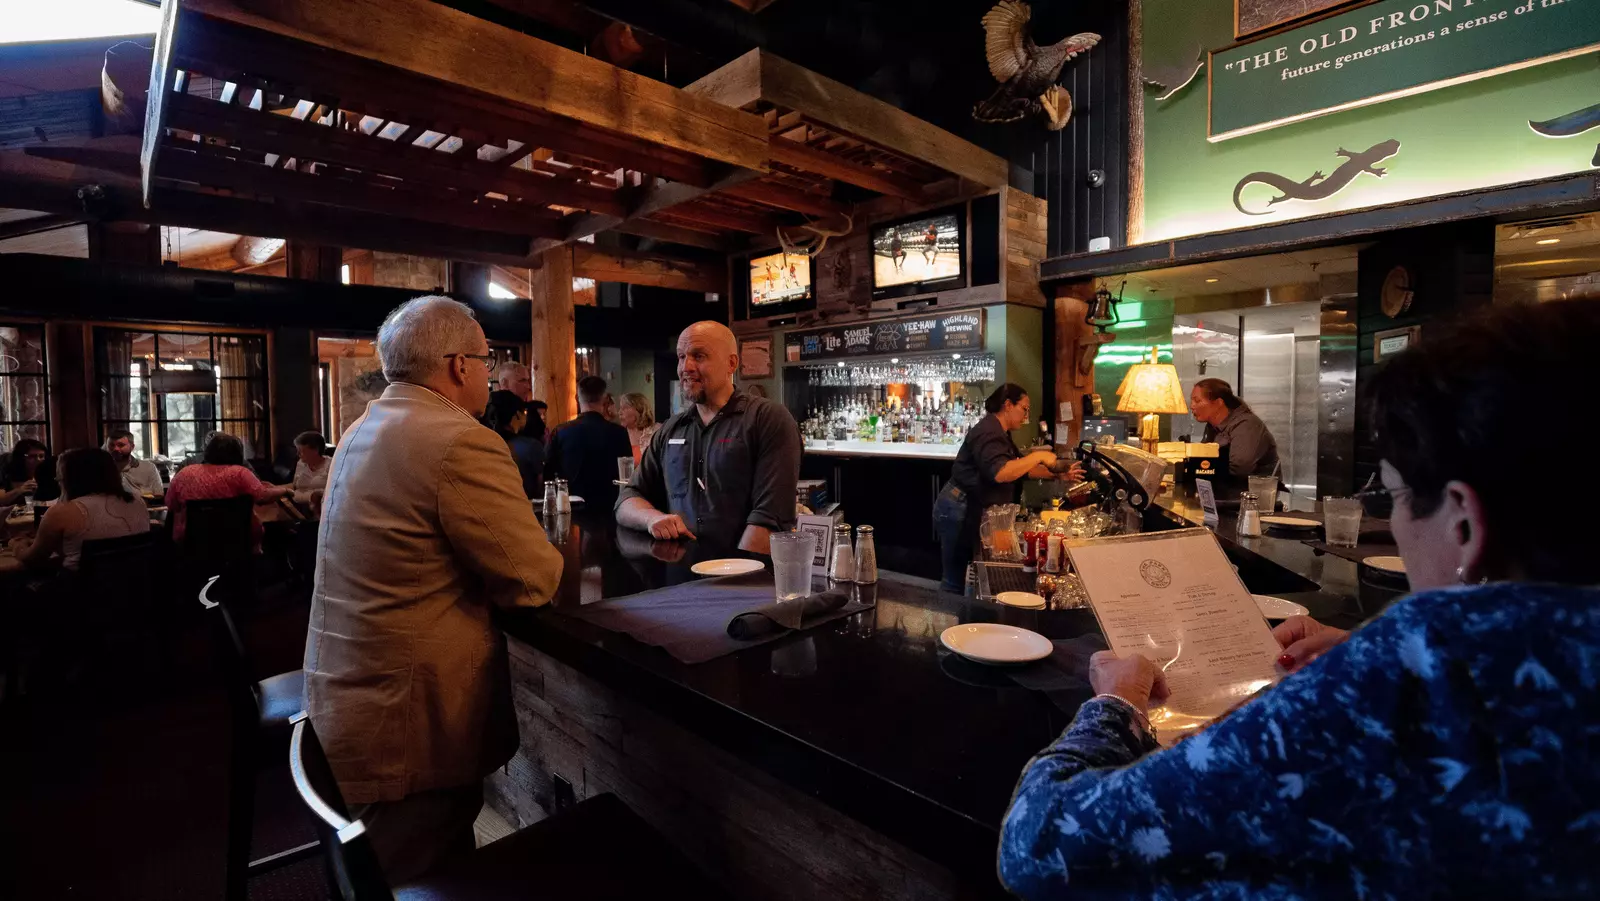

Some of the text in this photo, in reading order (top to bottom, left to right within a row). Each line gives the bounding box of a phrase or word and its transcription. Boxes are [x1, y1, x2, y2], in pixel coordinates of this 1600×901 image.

[1281, 60, 1331, 81] future
[1335, 30, 1435, 69] generations
[1440, 26, 1451, 36] a
[1455, 10, 1508, 32] sense
[1514, 0, 1537, 15] of
[1300, 26, 1358, 54] OLD
[942, 315, 979, 327] HIGHLAND
[844, 327, 873, 340] SAMUEL
[946, 324, 973, 332] BREWING
[804, 336, 819, 345] BUD
[825, 336, 841, 351] Lite
[845, 336, 870, 348] ADAMS
[801, 344, 822, 355] LIGHT
